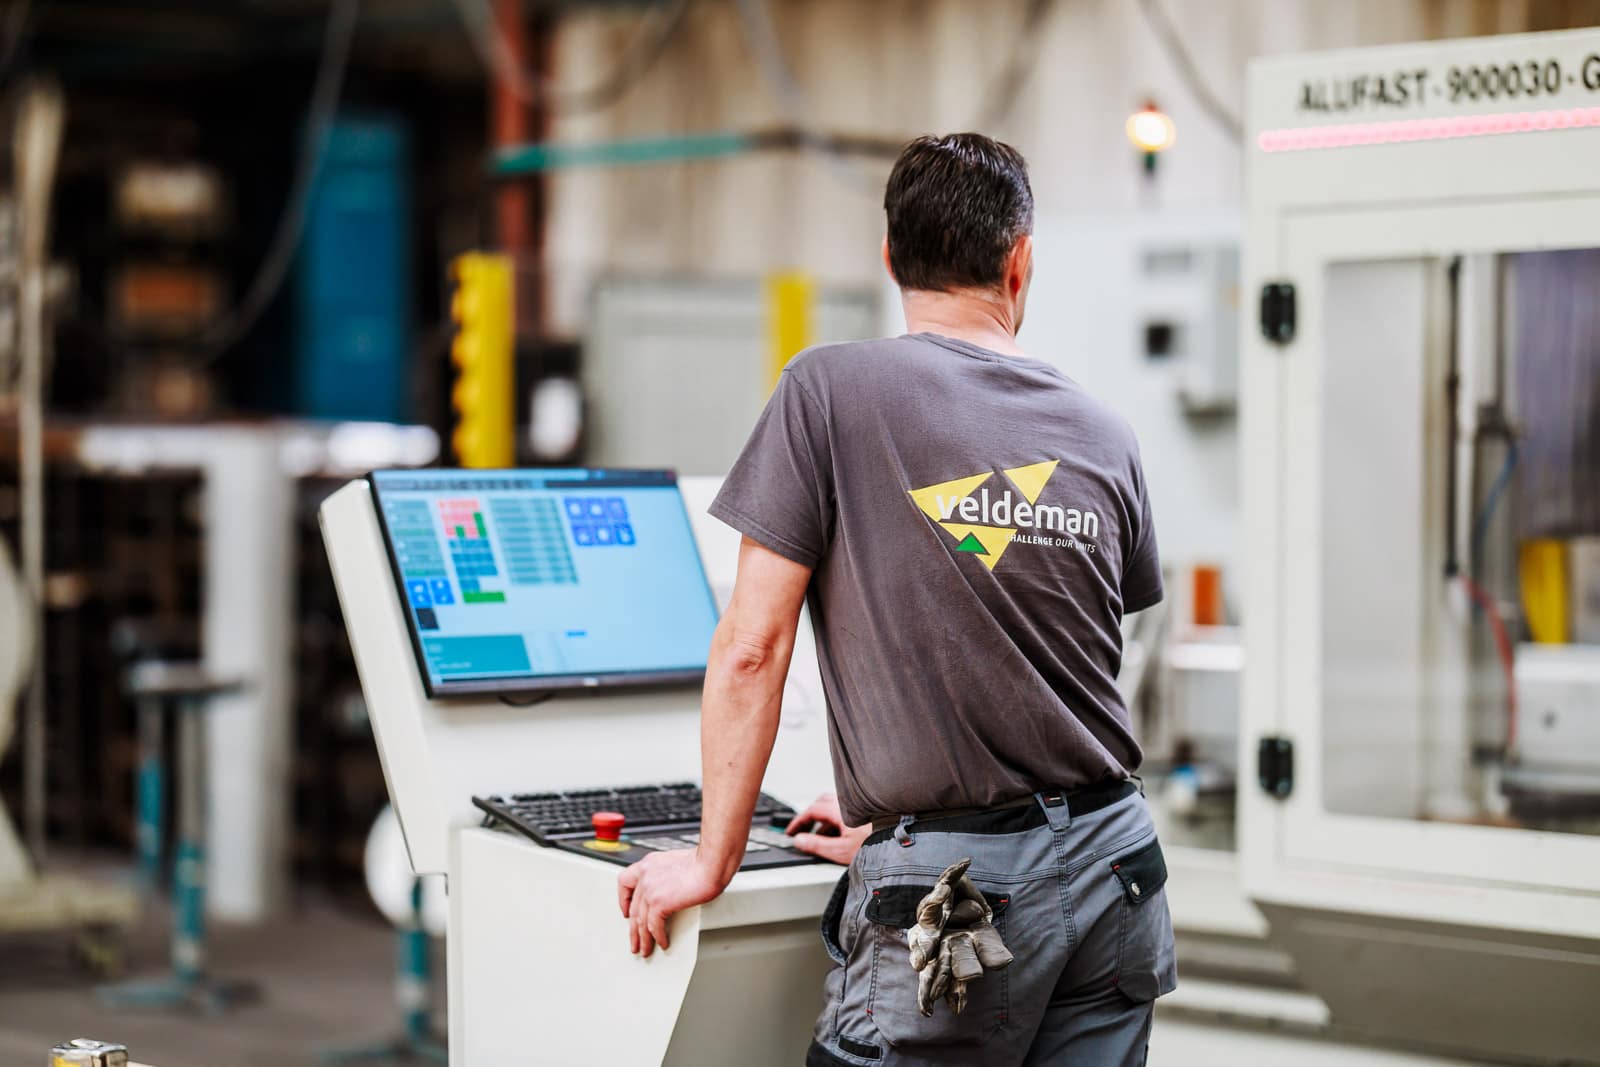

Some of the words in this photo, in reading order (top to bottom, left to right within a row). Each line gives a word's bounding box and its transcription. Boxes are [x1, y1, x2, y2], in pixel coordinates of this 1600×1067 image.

[1448, 59, 1560, 102] 900030
[935, 488, 1099, 538] veldeman
[1055, 538, 1074, 549] OUR
